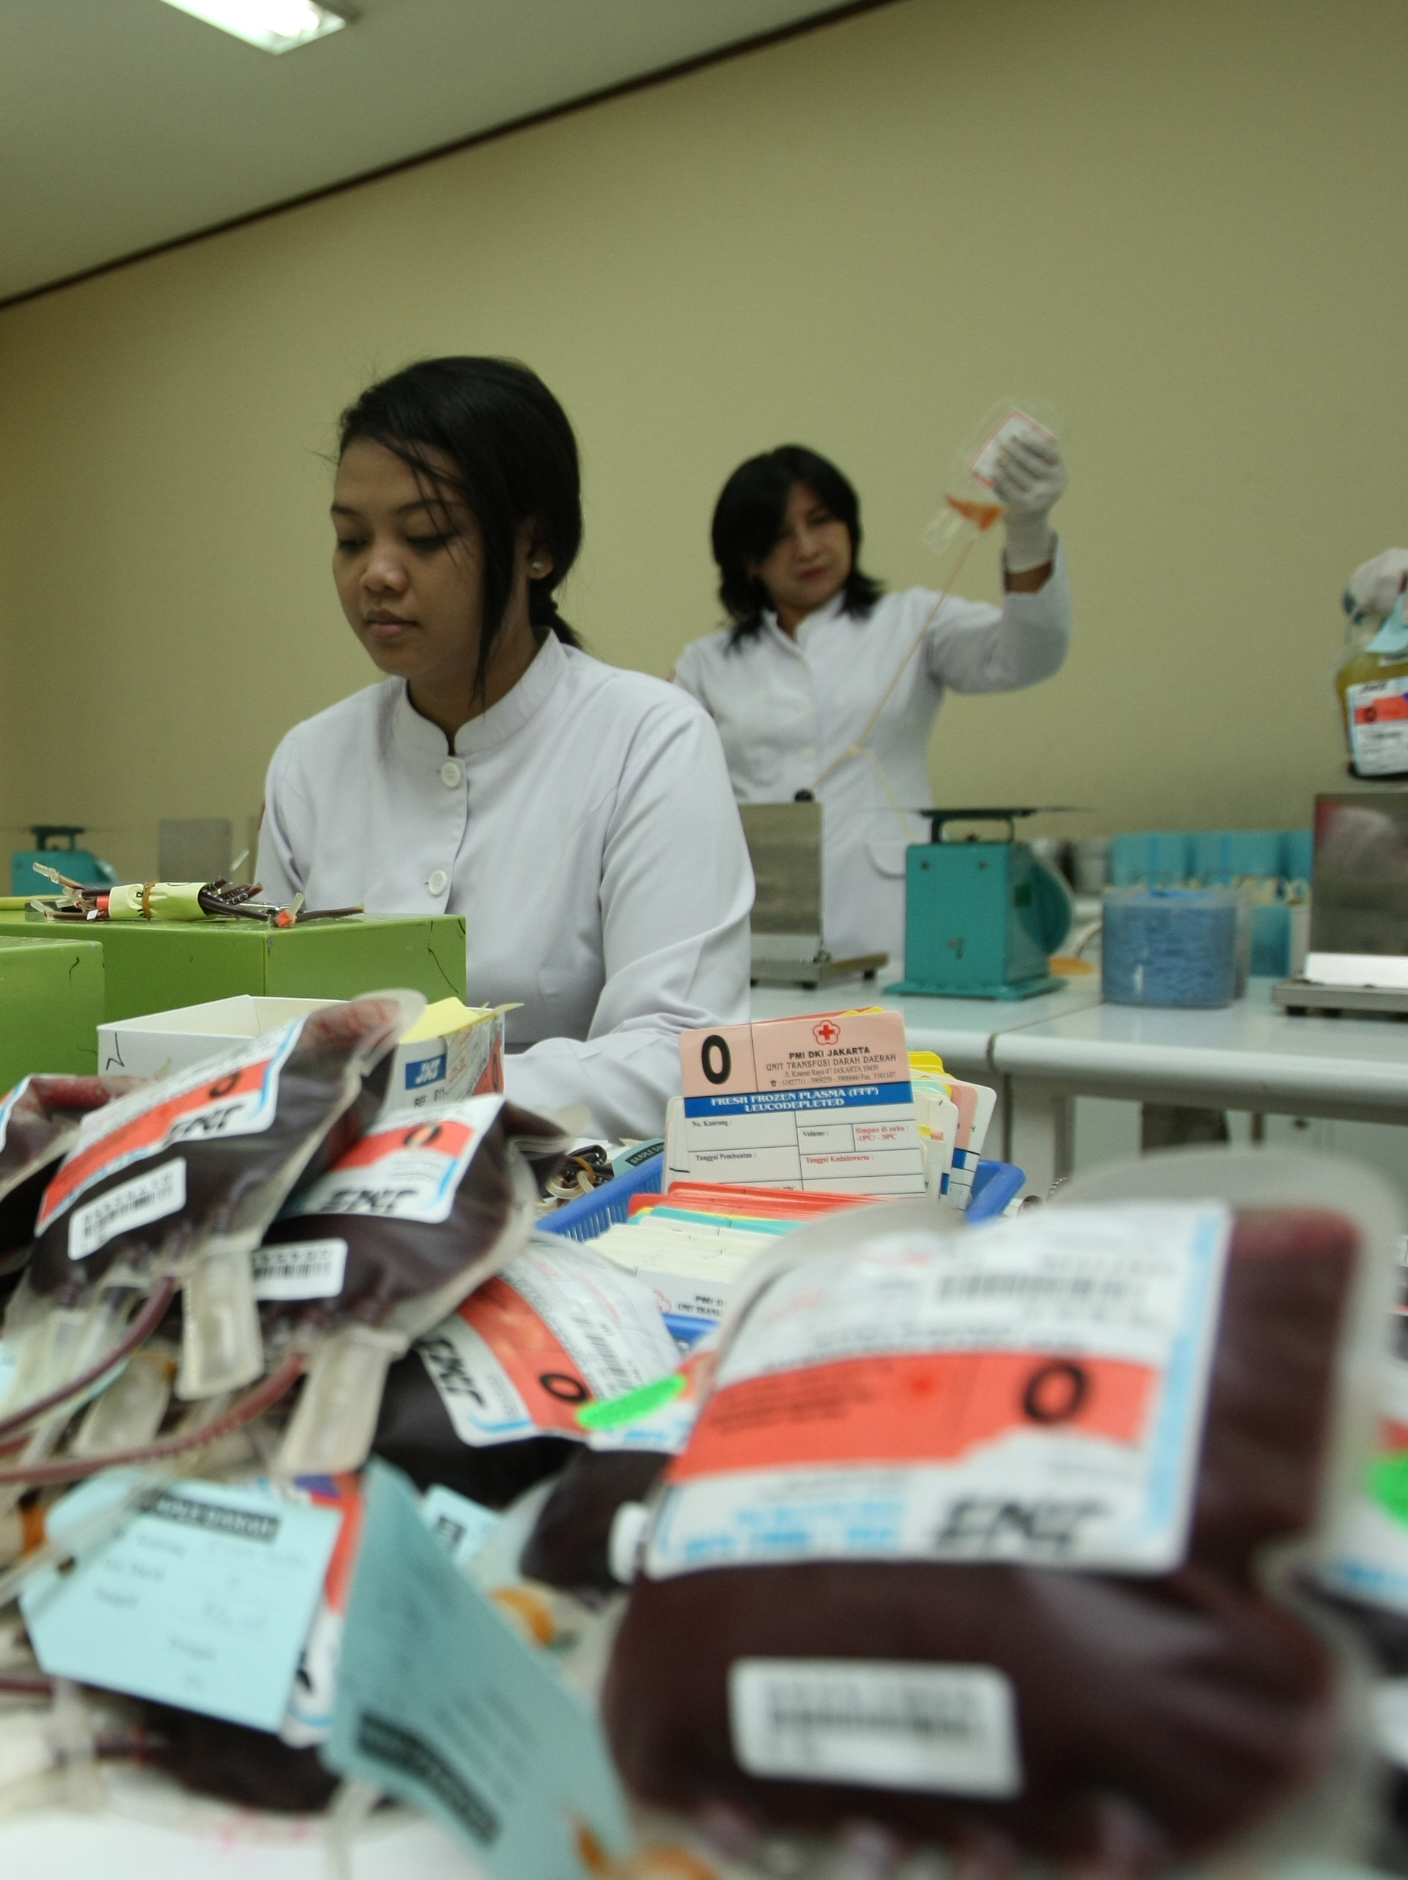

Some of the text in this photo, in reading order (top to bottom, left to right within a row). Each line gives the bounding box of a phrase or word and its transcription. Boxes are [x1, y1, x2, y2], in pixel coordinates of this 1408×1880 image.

[789, 1046, 870, 1060] PMI DKI JAKARTA
[766, 1054, 897, 1071] UNIT TRANSFUSI DARAH DAERAH
[833, 1066, 862, 1075] JAKARTA
[711, 1086, 880, 1107] FRESH FROZEN PLASMA (FFP)
[744, 1098, 845, 1113] LEUCODEPLETED
[806, 1156, 830, 1164] Tanggal
[695, 1295, 713, 1304] PMI
